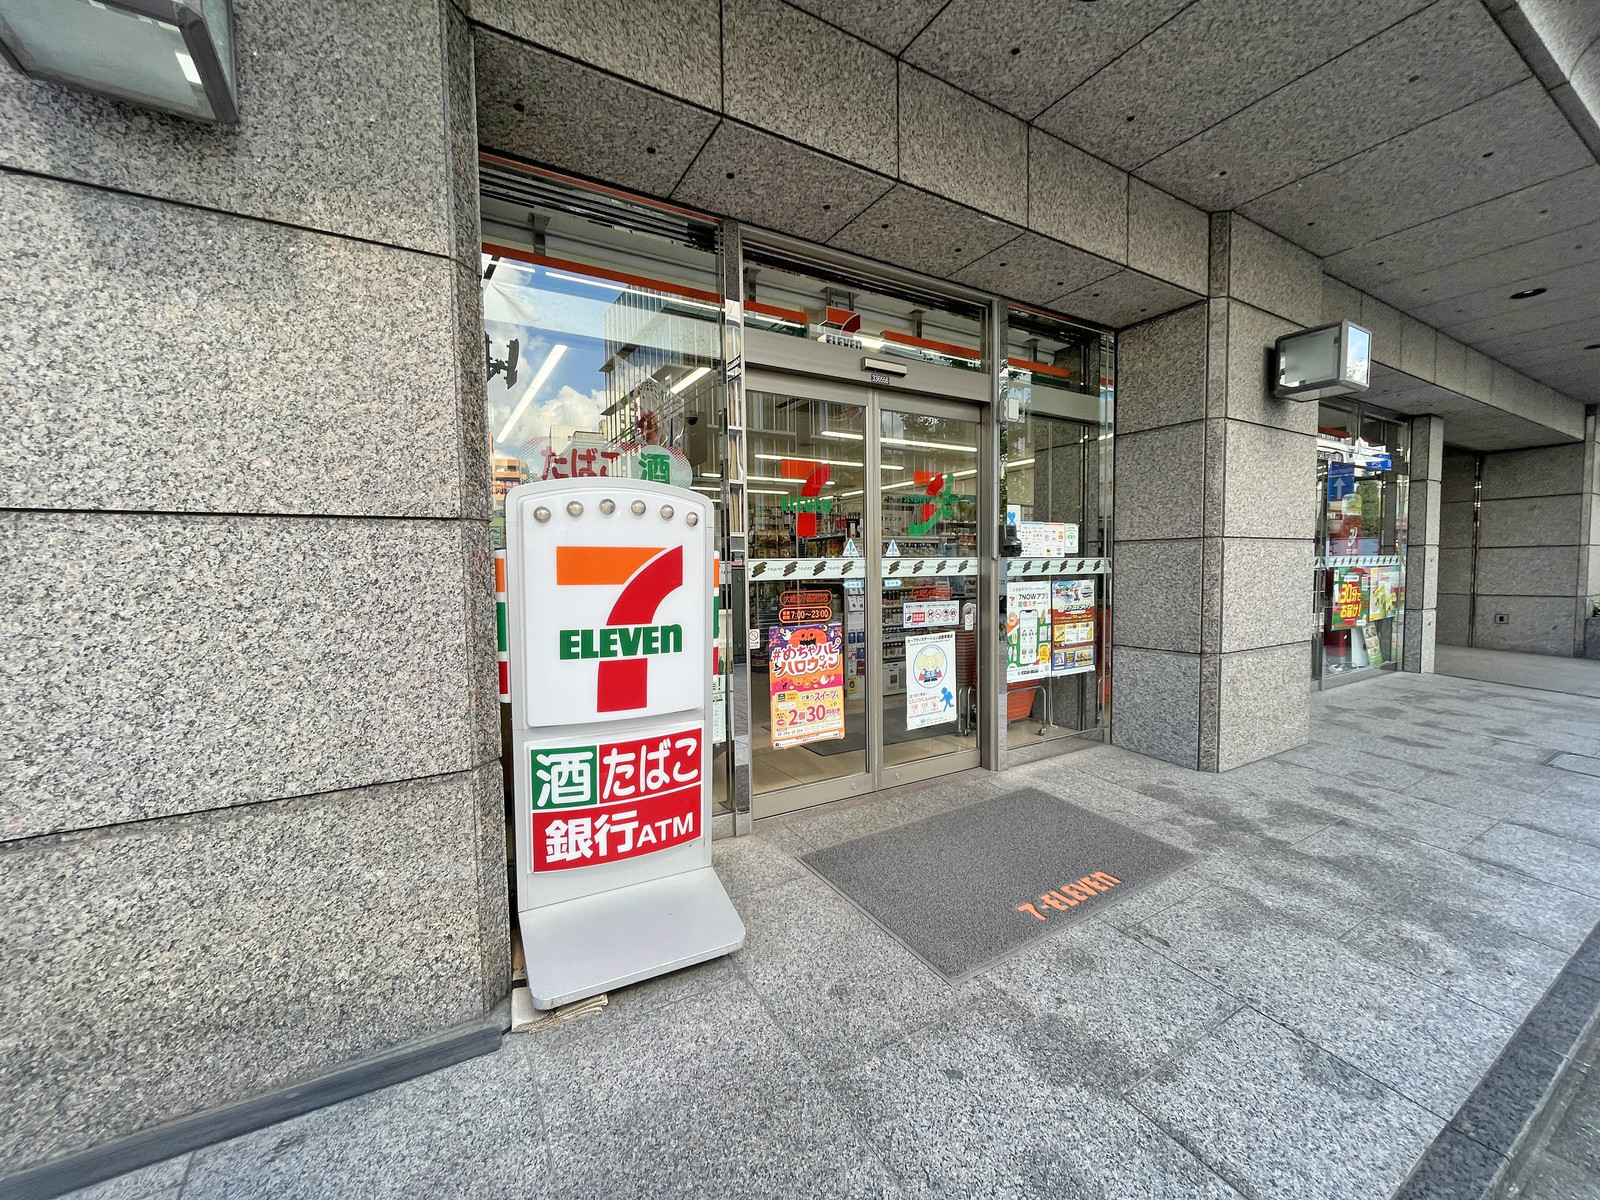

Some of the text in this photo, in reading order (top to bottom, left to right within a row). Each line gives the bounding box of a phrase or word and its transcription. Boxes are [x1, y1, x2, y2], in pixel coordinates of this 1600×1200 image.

[536, 738, 699, 807] 酒 たばこ
